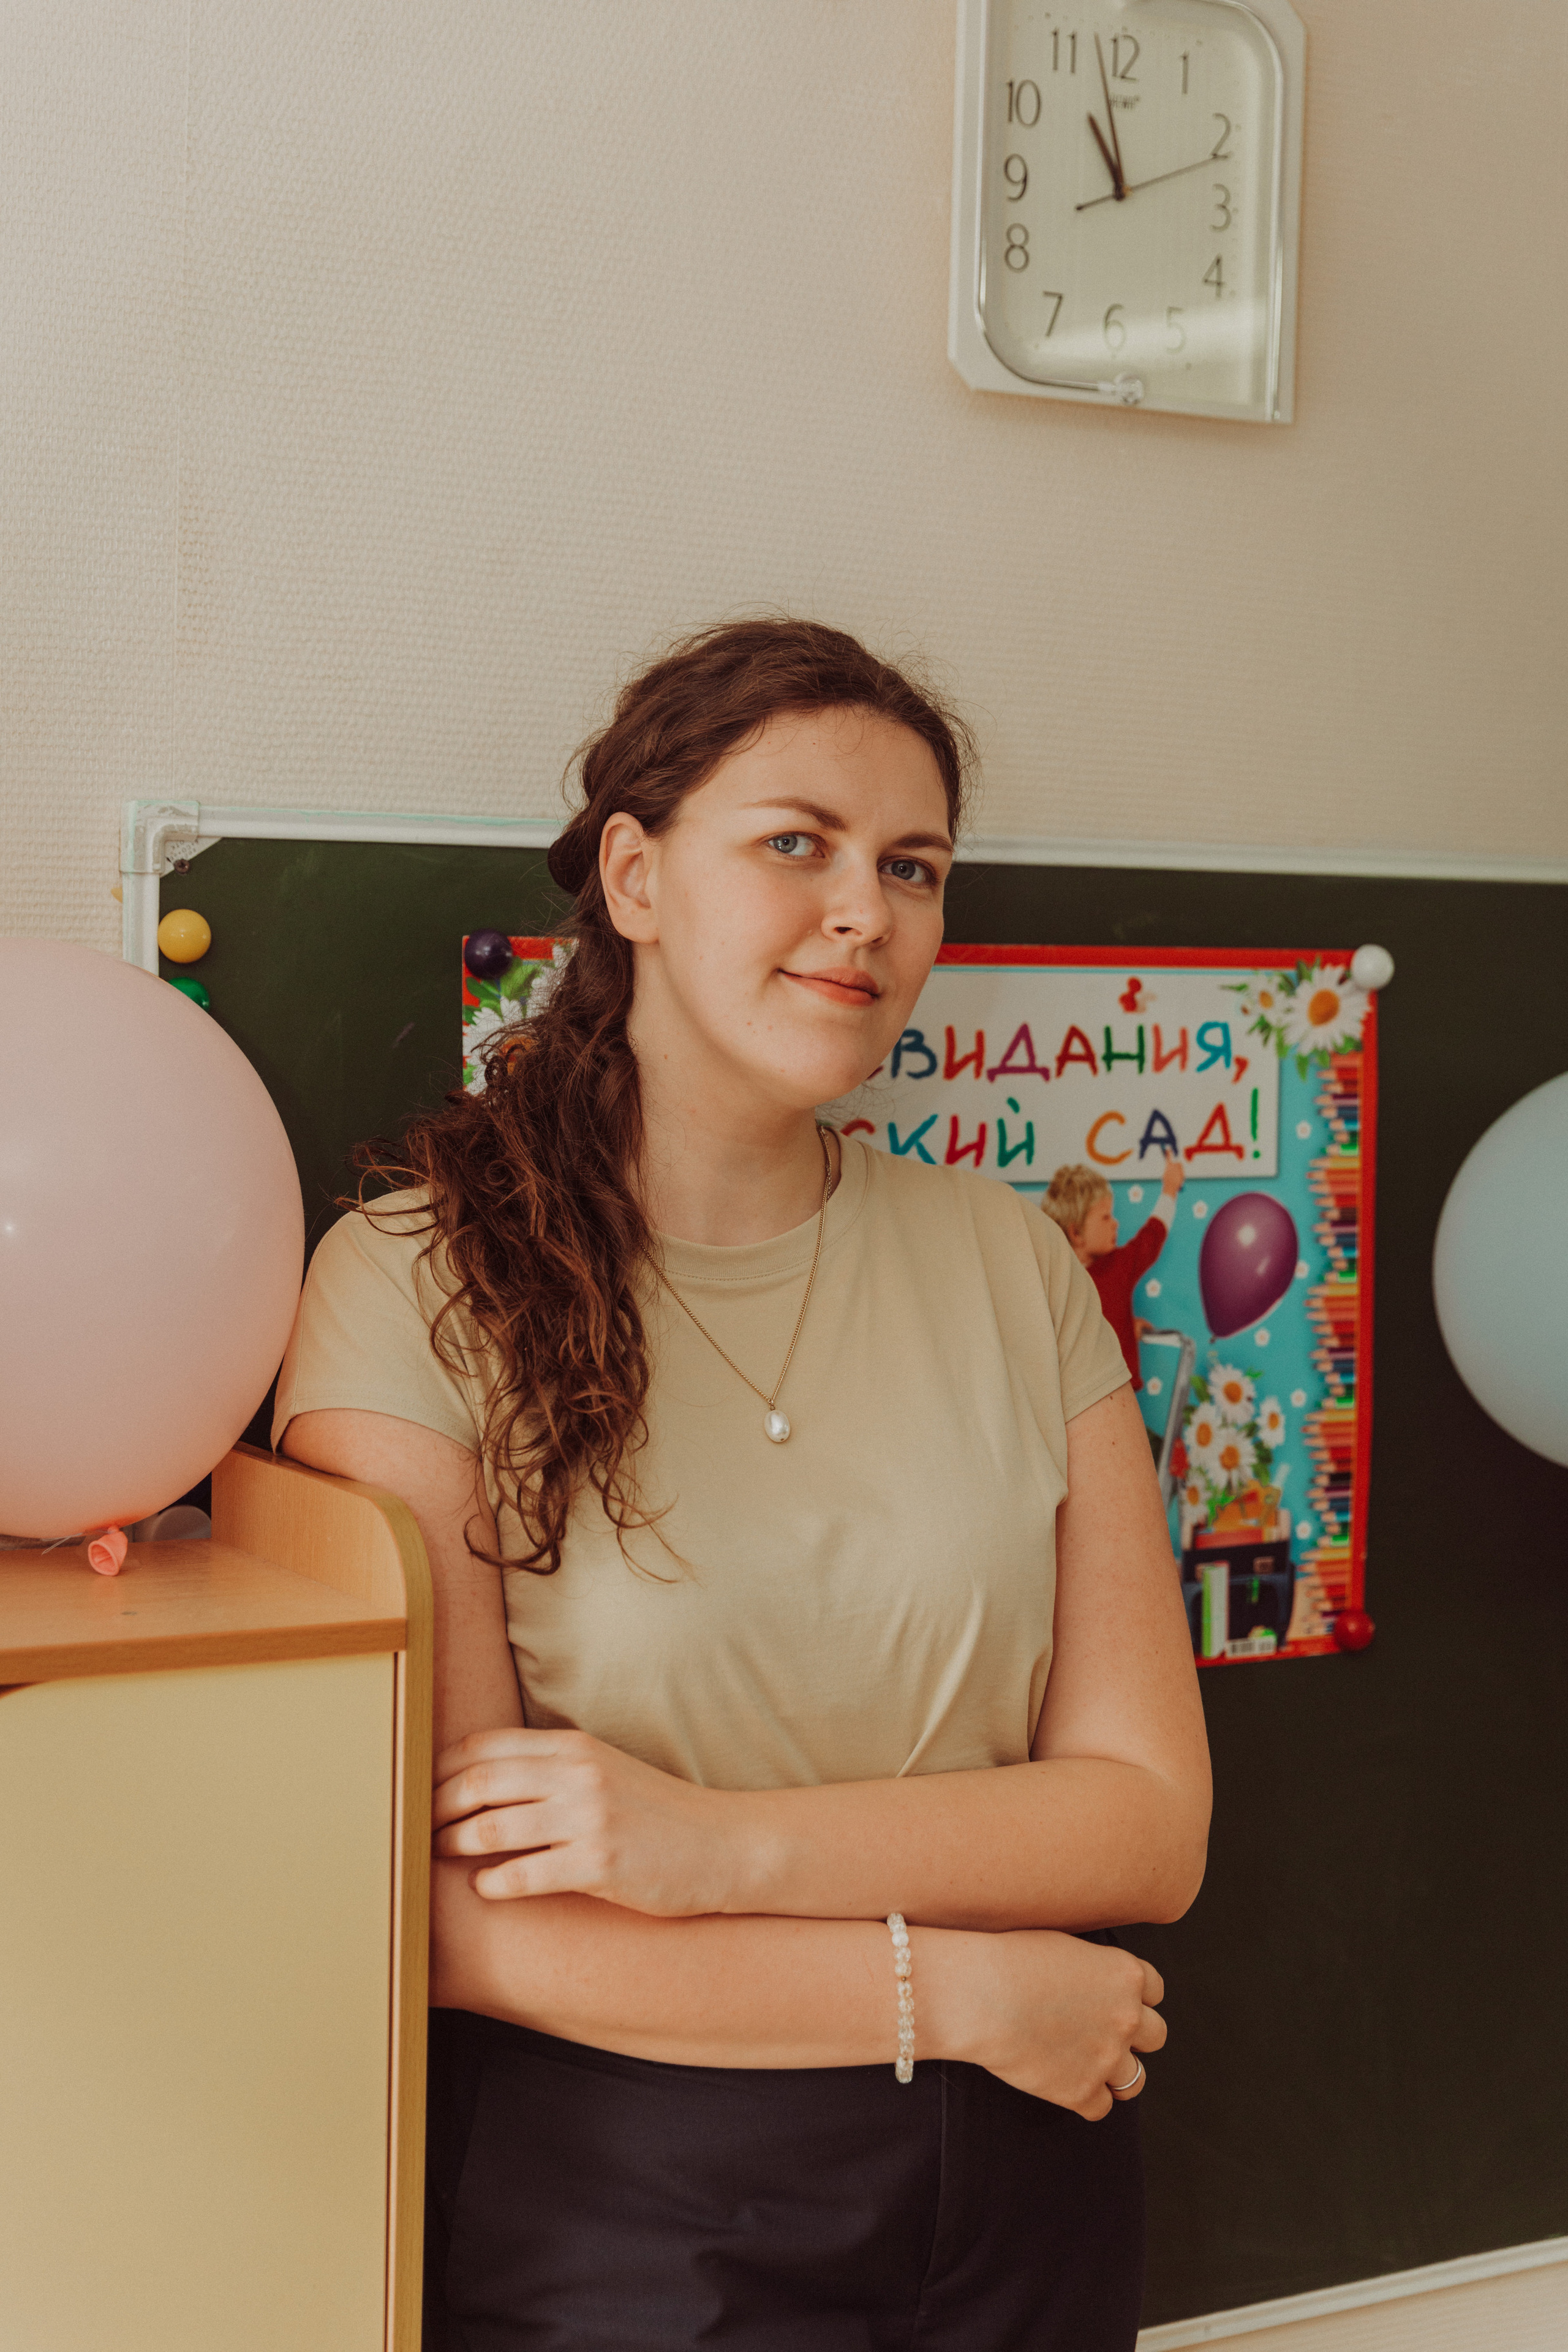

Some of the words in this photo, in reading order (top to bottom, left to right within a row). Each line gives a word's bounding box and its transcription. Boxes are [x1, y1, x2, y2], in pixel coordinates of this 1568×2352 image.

[1052, 27, 1077, 74] 11
[1110, 33, 1140, 83] 12
[1180, 50, 1189, 94] 1
[1006, 79, 1041, 128] 10
[1210, 112, 1232, 160] 2
[1003, 153, 1029, 202] 9
[1210, 183, 1232, 232] 3
[1005, 223, 1030, 273] 8
[1202, 253, 1226, 298] 4
[1043, 290, 1064, 337] 7
[1104, 304, 1126, 352] 6
[1166, 306, 1186, 353] 5
[865, 1022, 1249, 1083] ВИДАНИЯ,
[1085, 1087, 1263, 1165] САД!
